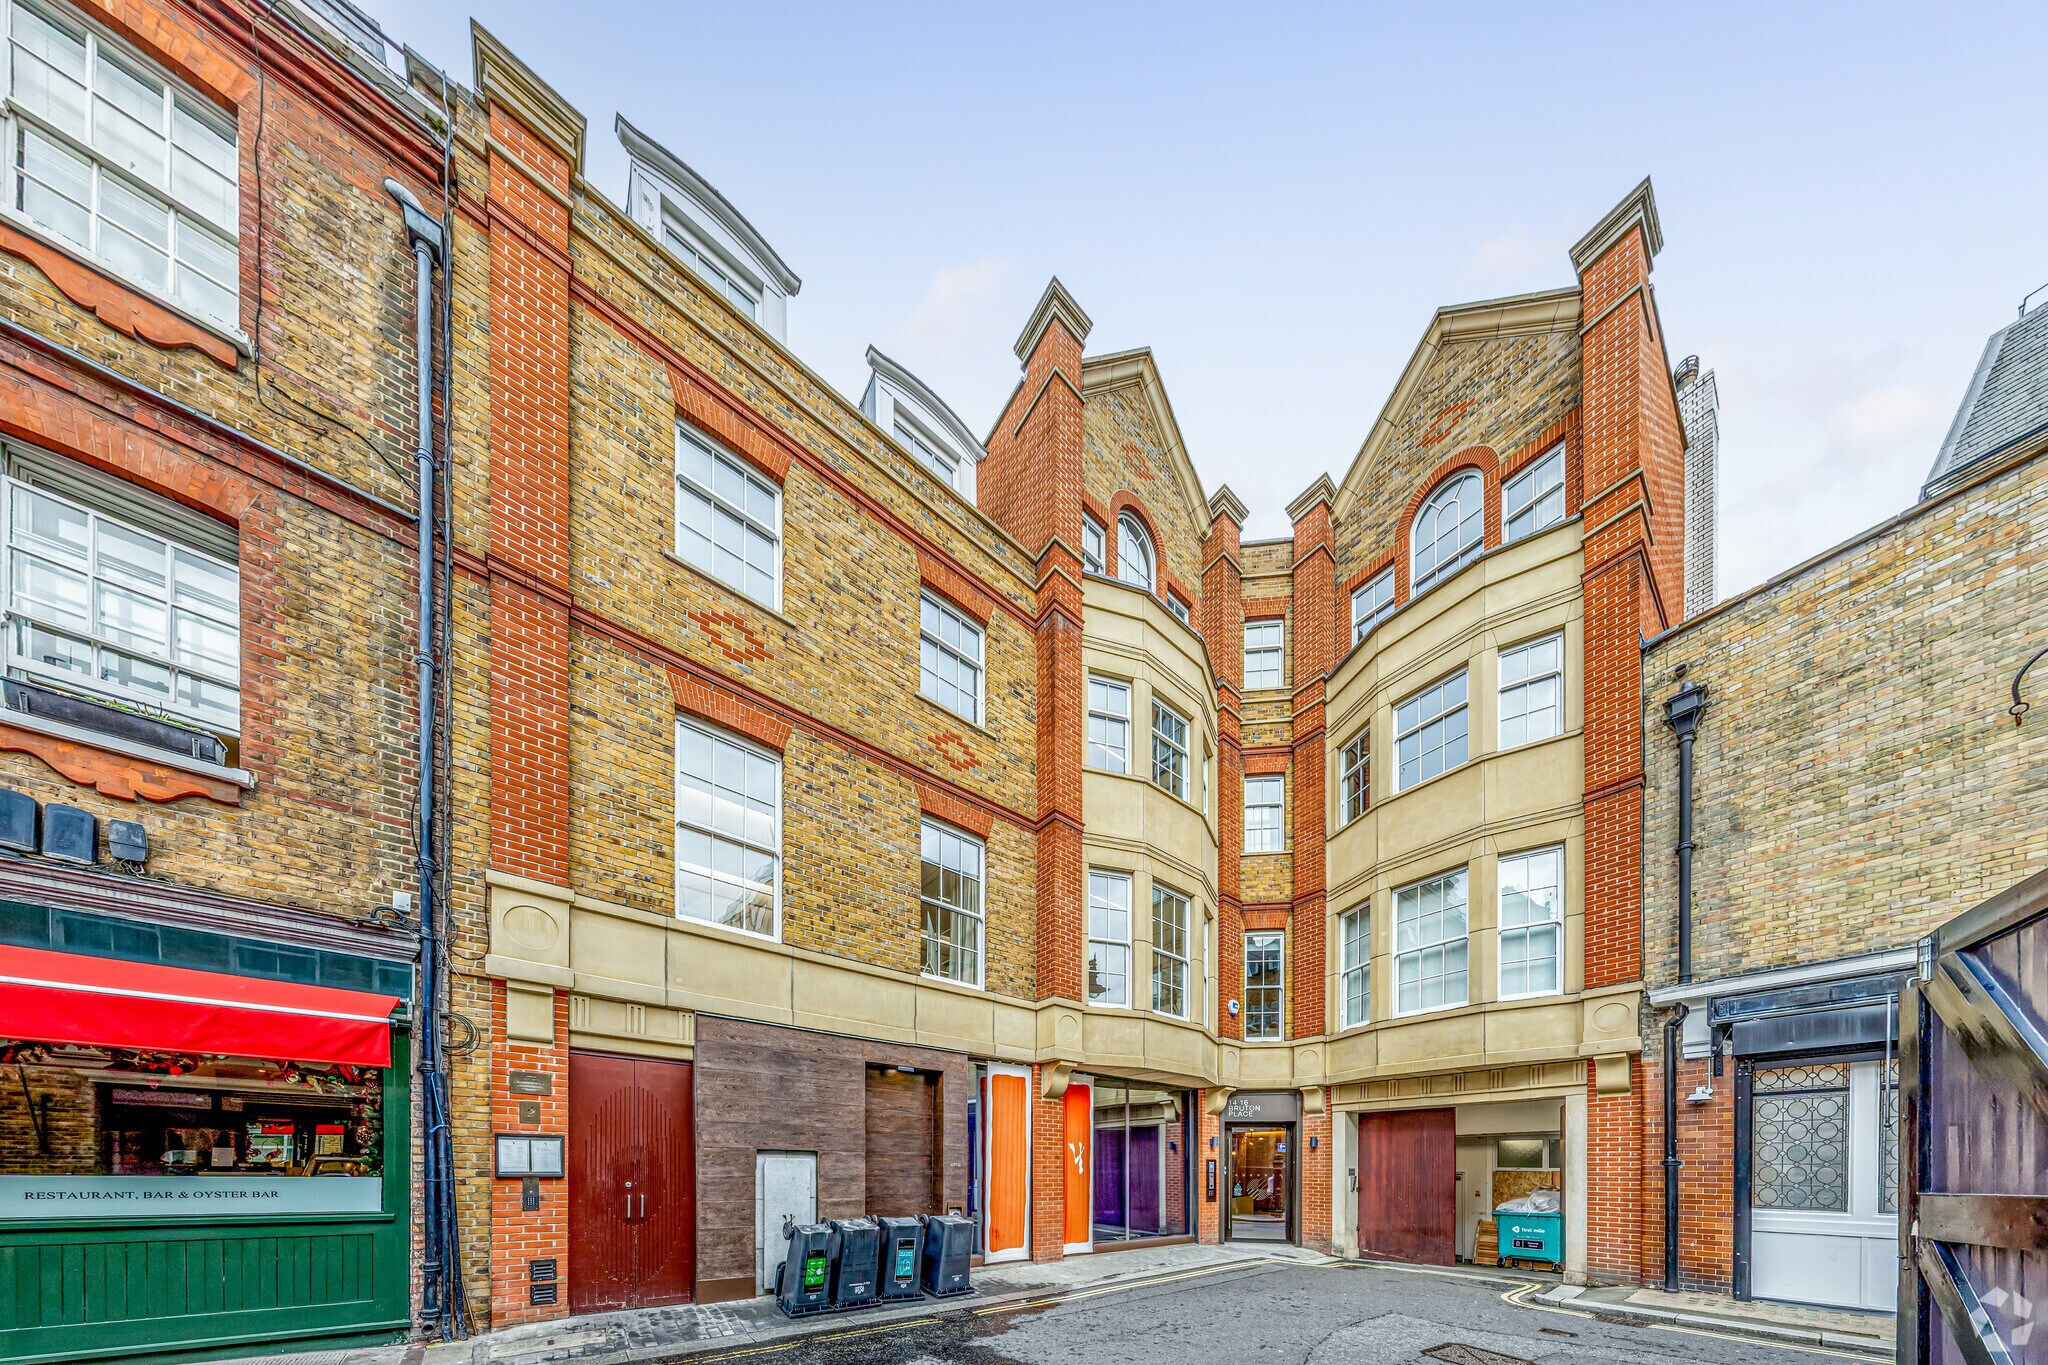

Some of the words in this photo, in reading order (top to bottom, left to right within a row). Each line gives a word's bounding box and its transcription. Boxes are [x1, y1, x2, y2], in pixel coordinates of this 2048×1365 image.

[24, 1191, 139, 1200] RESTAURANT,
[143, 1191, 174, 1199] BAR
[177, 1190, 189, 1199] &
[192, 1190, 248, 1199] OYSTER
[252, 1190, 280, 1198] BAR
